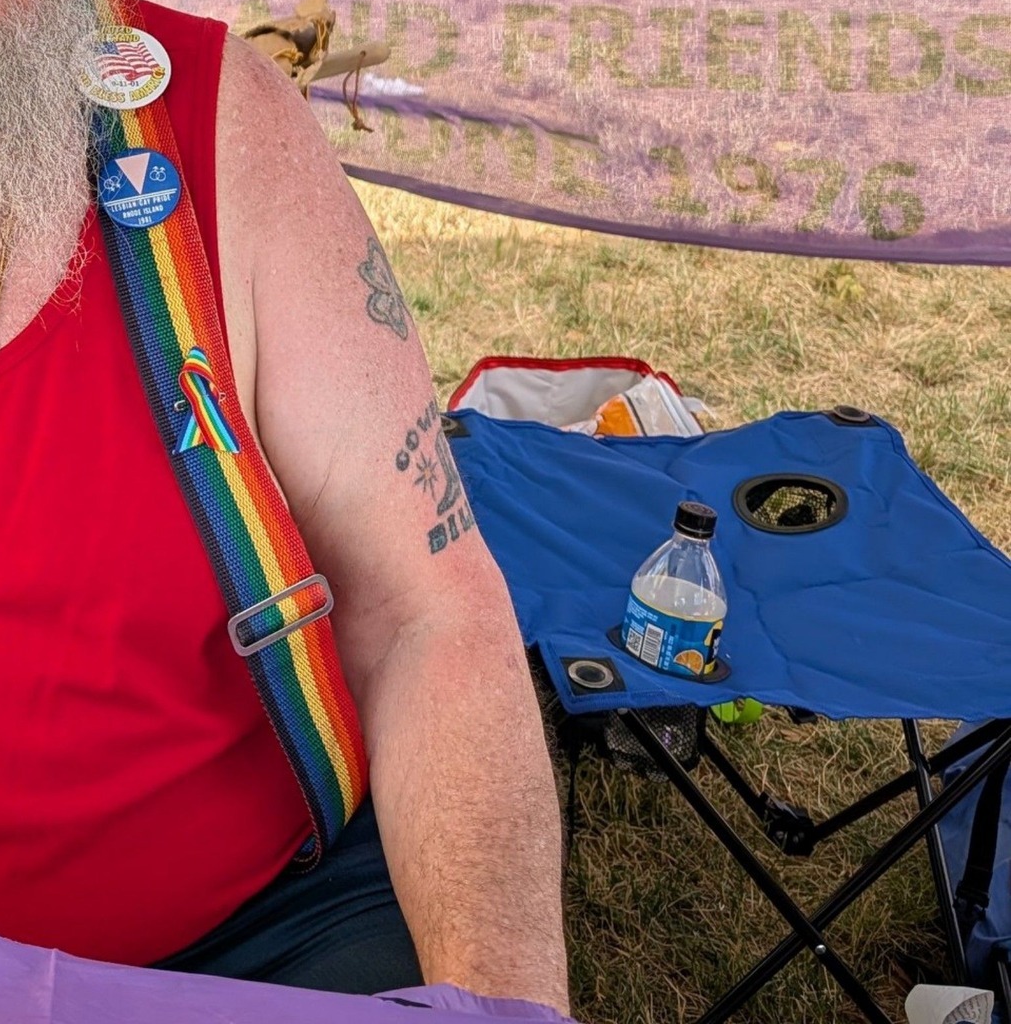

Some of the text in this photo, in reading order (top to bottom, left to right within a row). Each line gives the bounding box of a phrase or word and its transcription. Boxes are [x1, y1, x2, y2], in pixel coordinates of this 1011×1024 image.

[139, 198, 151, 207] GAY
[152, 193, 171, 204] PRIDE
[647, 144, 925, 242] 1976
[122, 204, 164, 219] RHODE ISLAND
